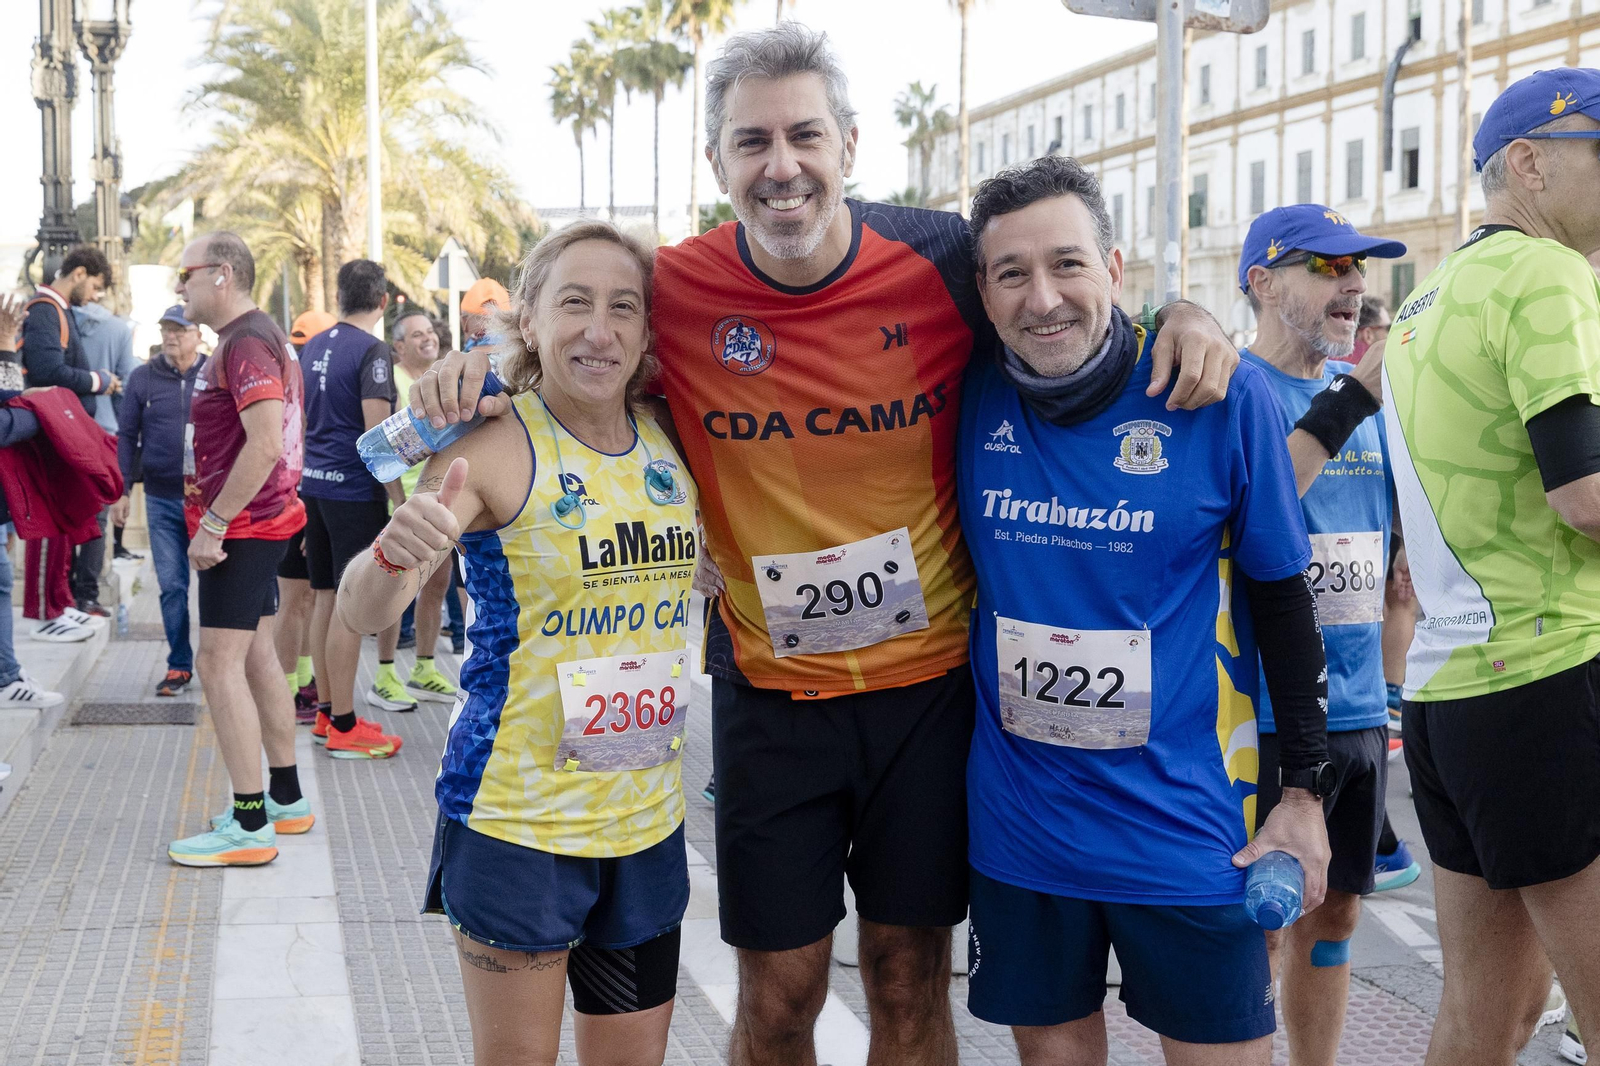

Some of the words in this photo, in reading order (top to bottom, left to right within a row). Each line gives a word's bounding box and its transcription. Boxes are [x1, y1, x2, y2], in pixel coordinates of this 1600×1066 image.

[1396, 286, 1440, 323] ALBERTO
[722, 341, 756, 359] CDAC
[703, 410, 795, 441] CDA
[805, 384, 947, 435] CAMAS
[1345, 450, 1359, 462] AL
[982, 488, 1155, 533] Tirabuzón
[994, 529, 1013, 541] Est.
[1015, 531, 1048, 545] Piedra
[1050, 535, 1093, 551] Pikachos
[583, 580, 599, 589] SE
[602, 574, 641, 587] SIENTA
[643, 573, 650, 582] A
[653, 572, 667, 581] LA
[1307, 560, 1376, 594] 2388
[796, 571, 884, 620] 290
[541, 602, 645, 637] OLIMPO
[1014, 656, 1125, 709] 1222
[582, 685, 676, 736] 2368
[972, 934, 981, 955] NEW
[969, 958, 981, 978] YORK
